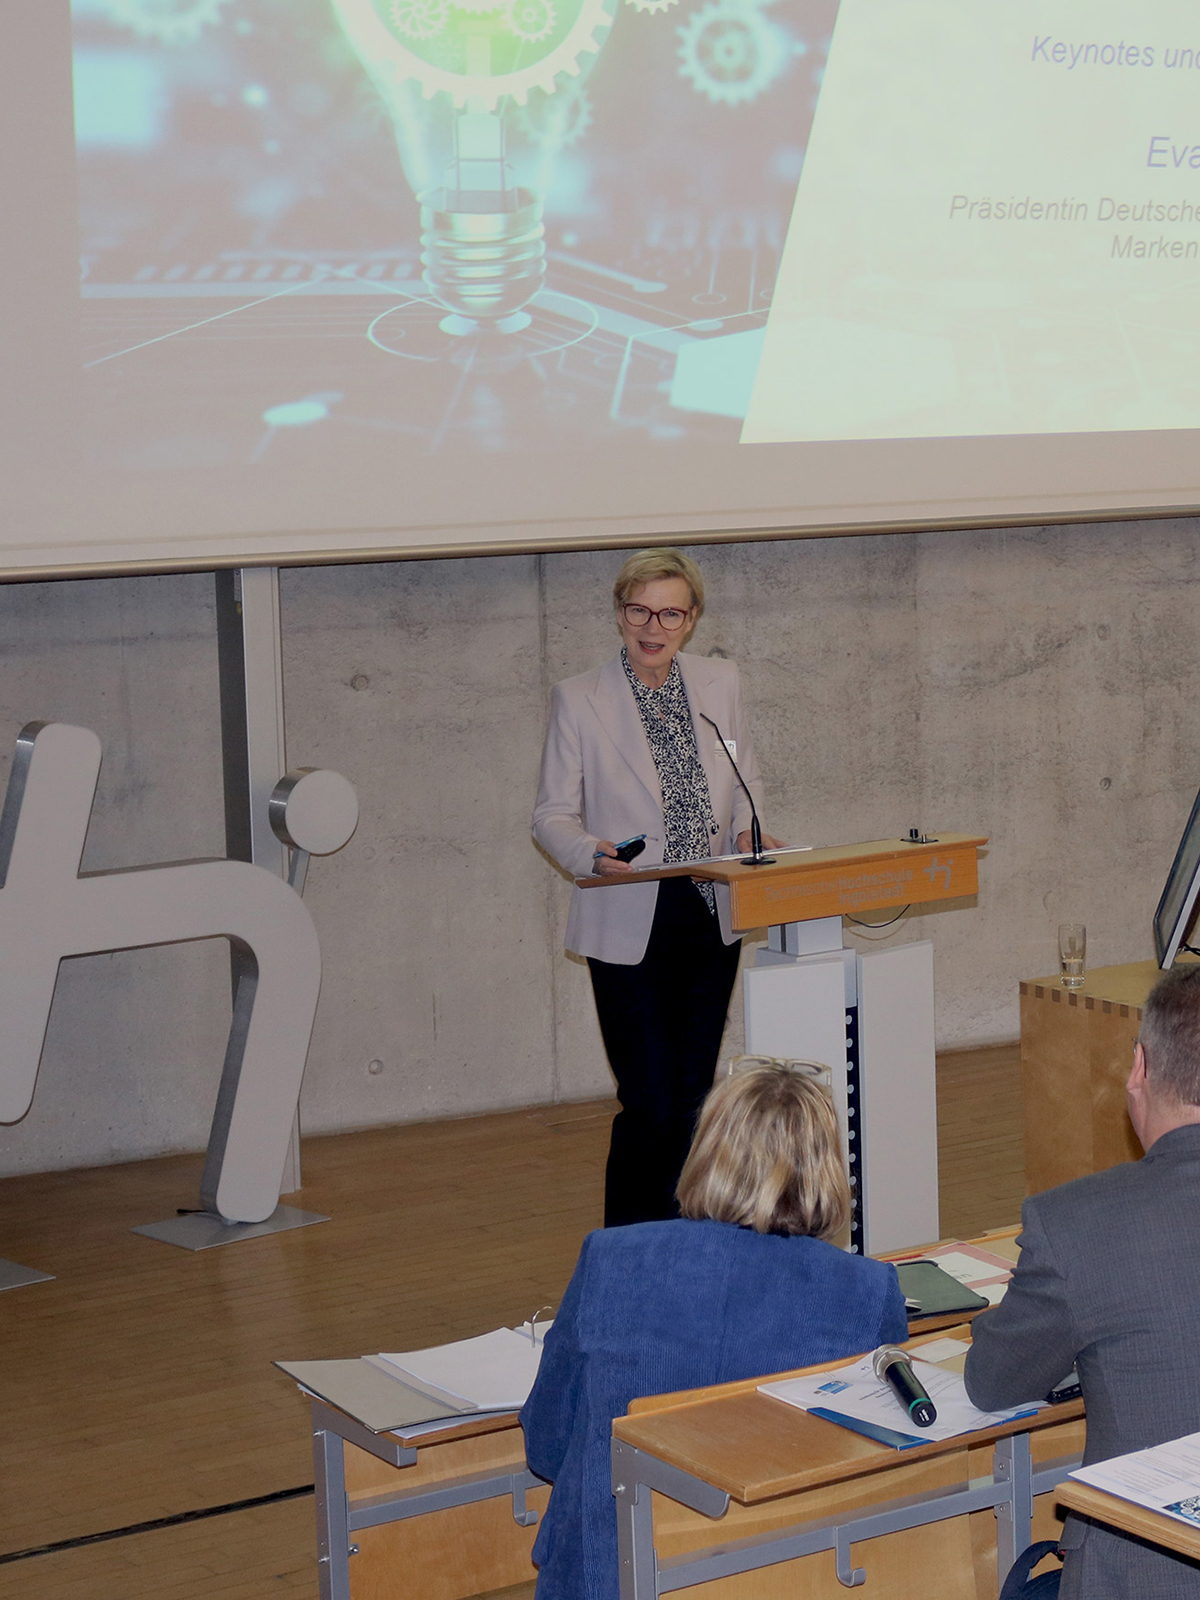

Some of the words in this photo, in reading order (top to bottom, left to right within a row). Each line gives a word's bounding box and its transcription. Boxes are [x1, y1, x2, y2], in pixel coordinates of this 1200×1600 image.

[1031, 35, 1155, 70] Keynotes
[948, 195, 1088, 221] Präsidentin
[765, 880, 836, 901] Technische
[837, 868, 914, 891] Hochschule
[838, 883, 904, 908] Ingolstadt
